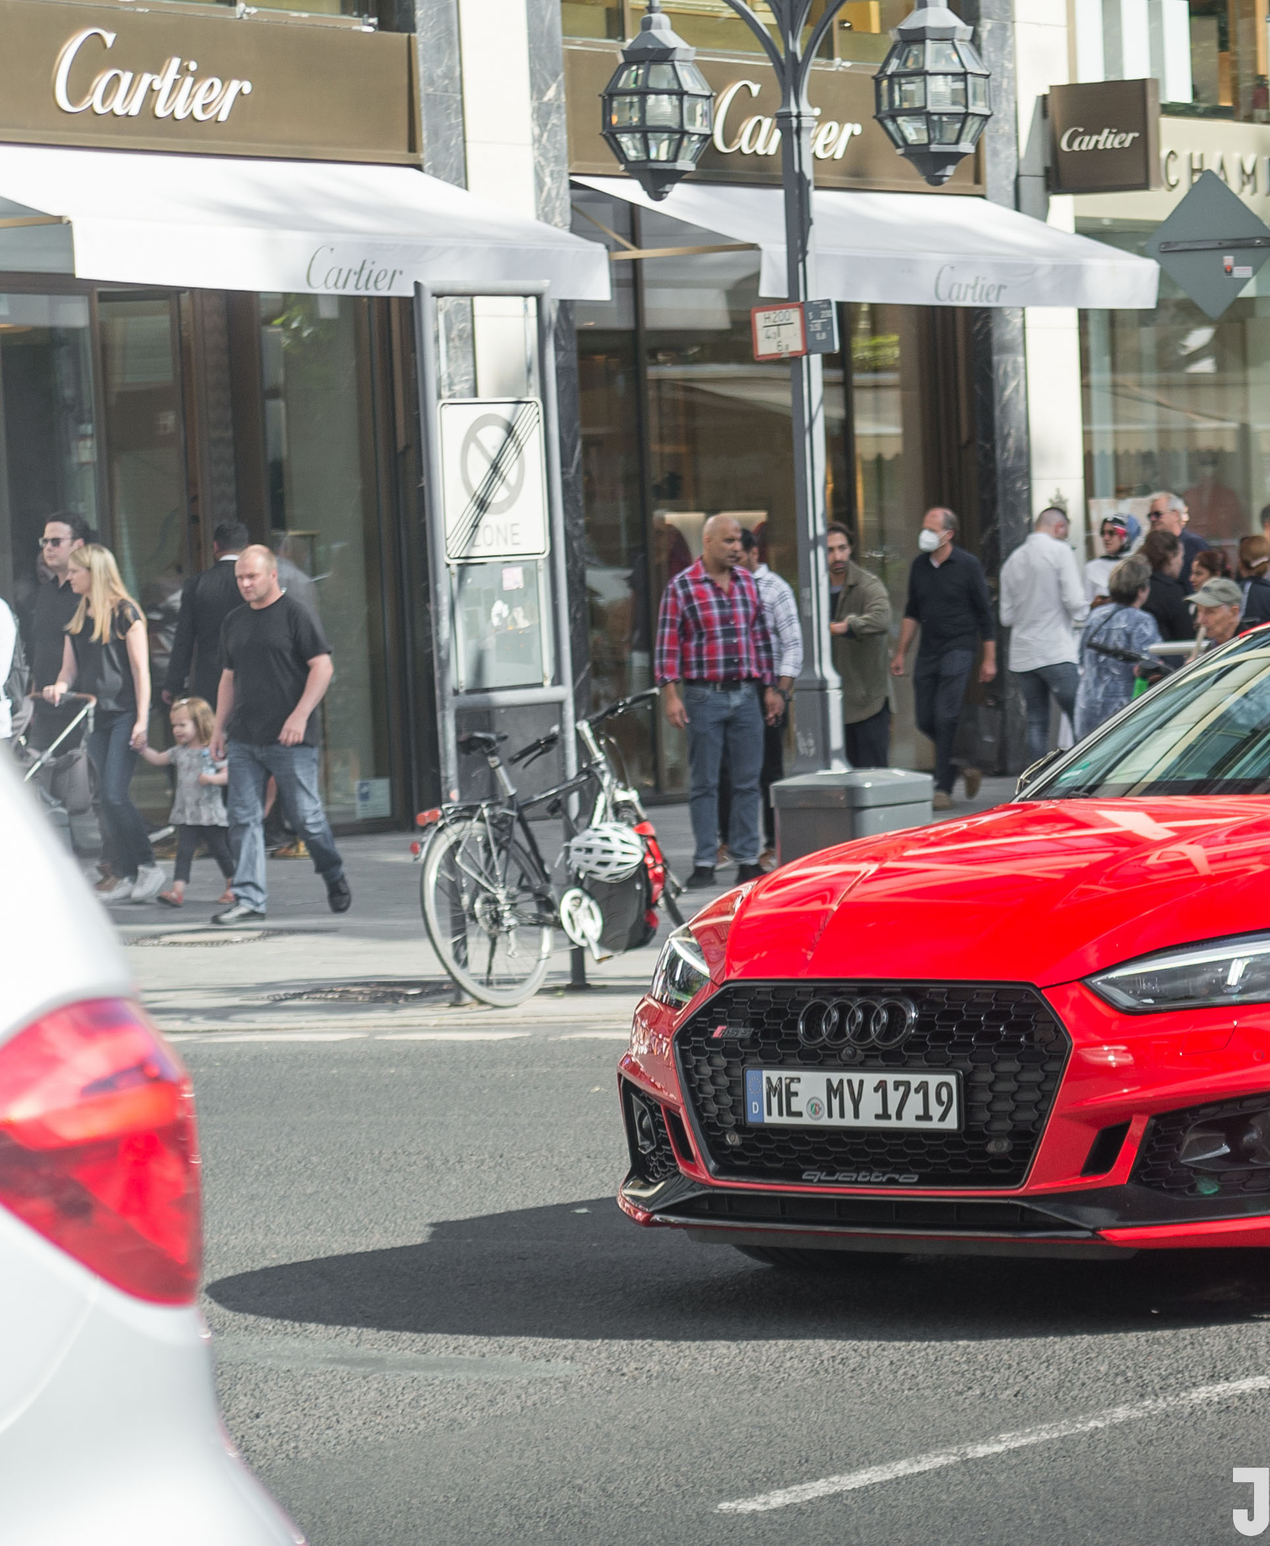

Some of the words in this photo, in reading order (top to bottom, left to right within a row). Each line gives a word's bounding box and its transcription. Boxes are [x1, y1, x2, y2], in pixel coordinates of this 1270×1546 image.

[53, 26, 253, 122] Cartier
[713, 79, 862, 159] Carer
[1060, 126, 1140, 152] Cartier
[306, 244, 404, 292] Cartier
[934, 263, 1008, 304] Cartier
[471, 522, 521, 548] ZONE
[752, 1101, 759, 1114] D
[765, 1075, 804, 1118] ME
[826, 1077, 865, 1120] MY
[873, 1079, 954, 1123] 1719
[802, 1171, 919, 1183] quattro
